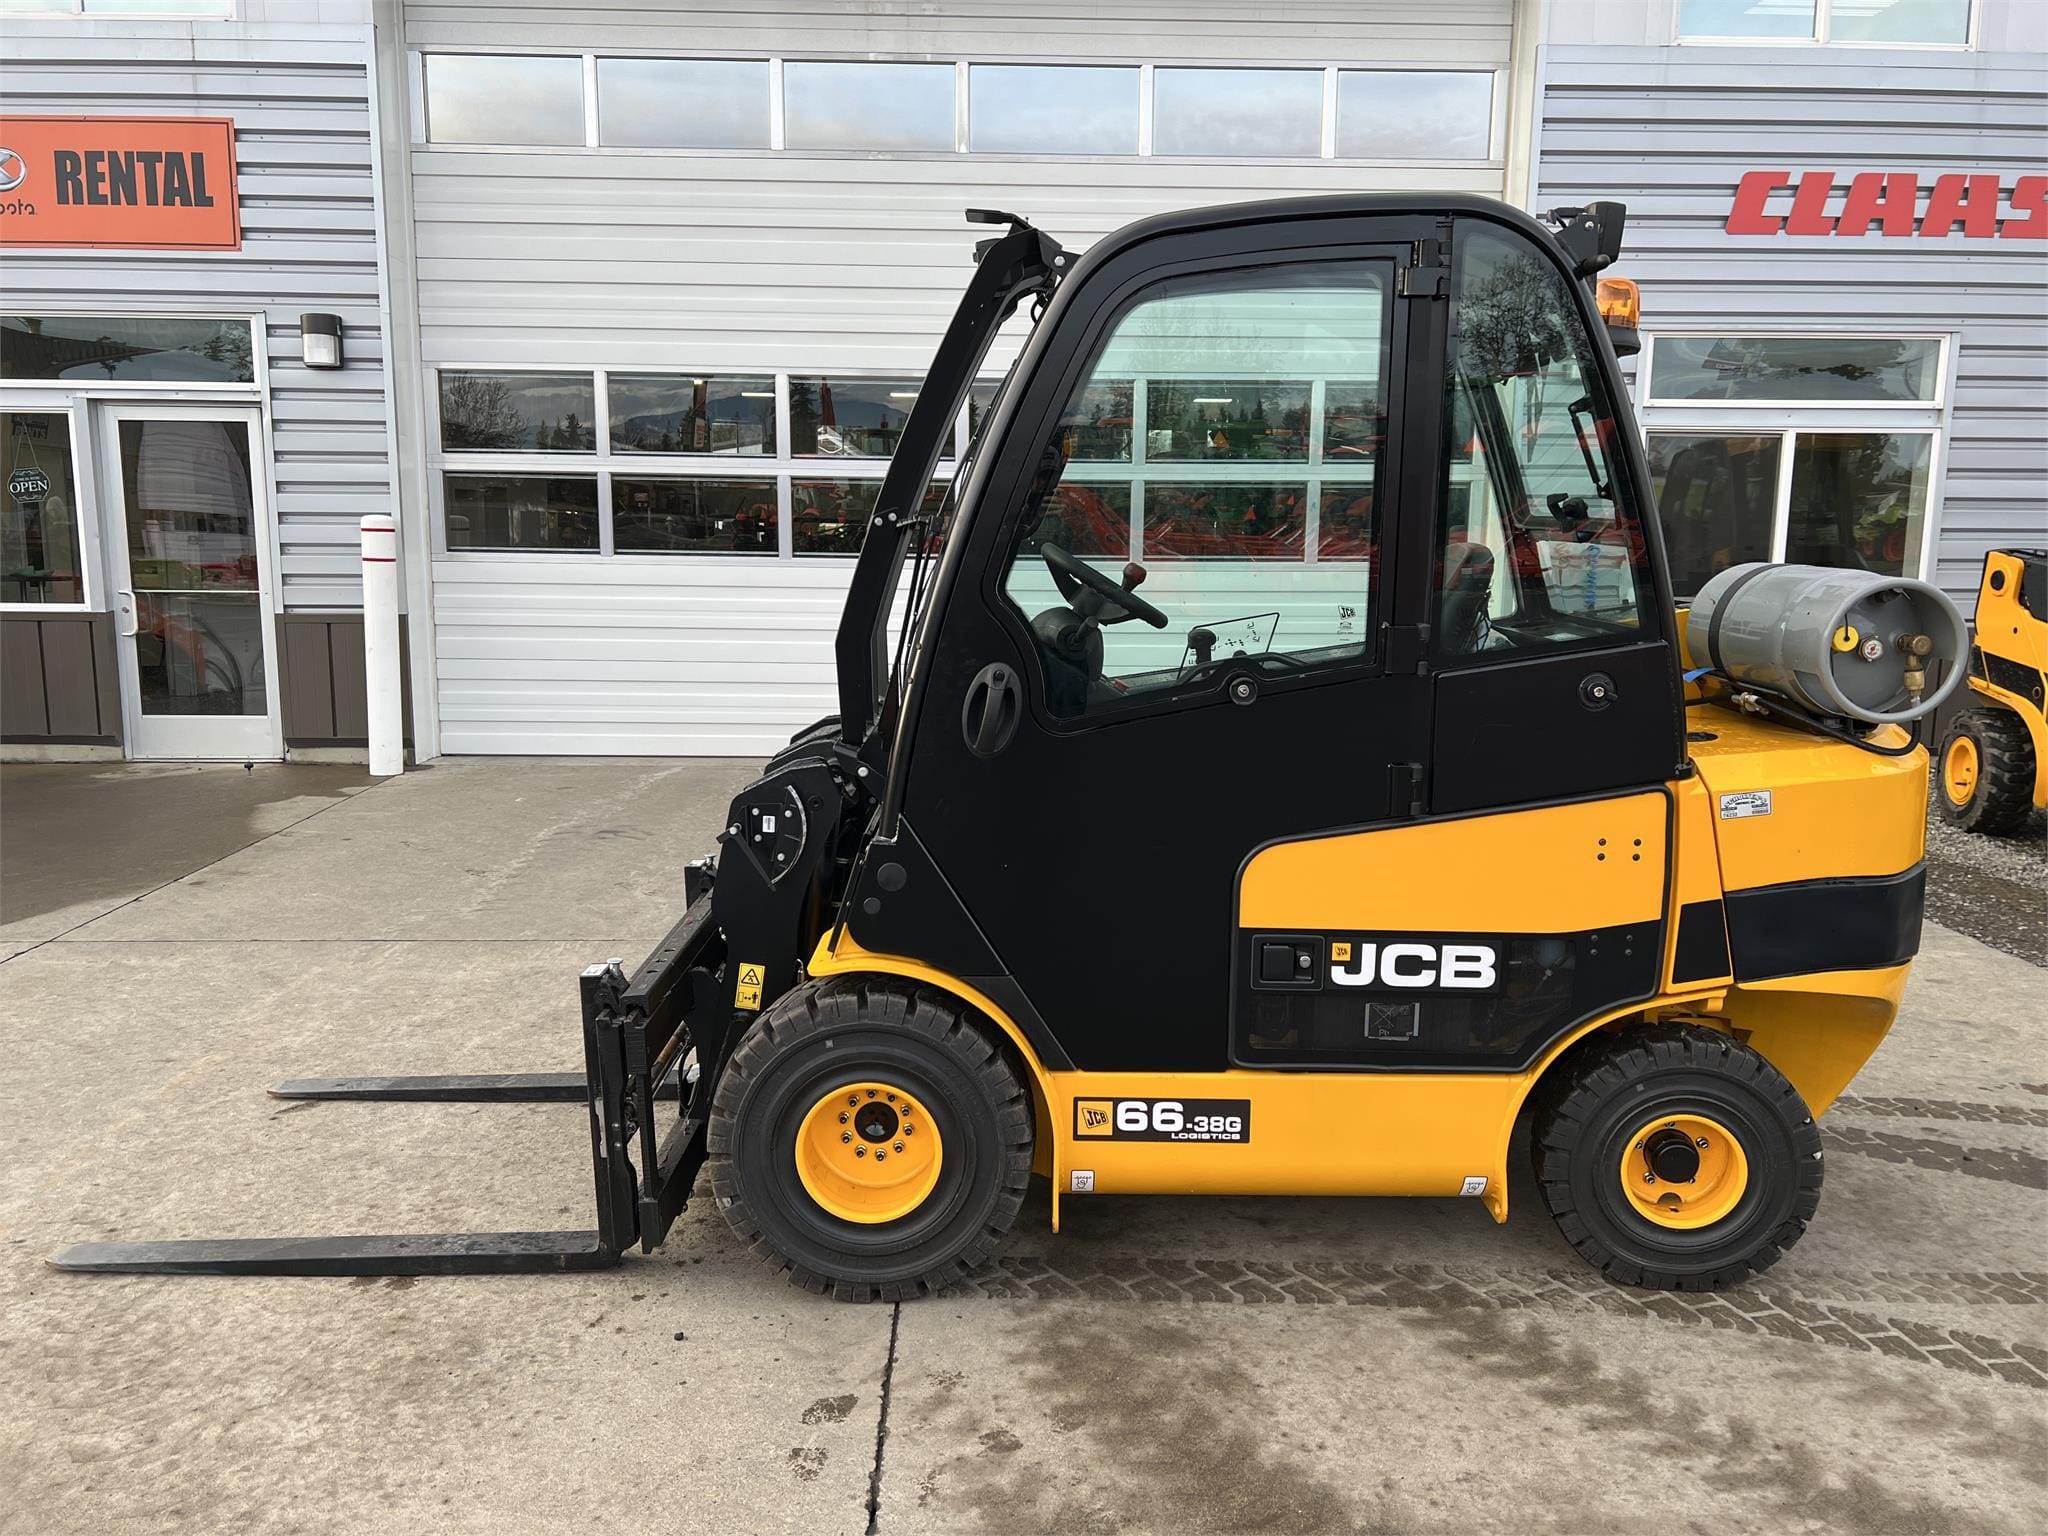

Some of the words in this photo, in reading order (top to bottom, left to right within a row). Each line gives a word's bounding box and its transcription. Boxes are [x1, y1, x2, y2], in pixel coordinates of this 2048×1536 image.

[54, 149, 214, 208] RENTAL
[9, 480, 48, 494] OPEN
[1330, 943, 1497, 988] JCB
[1086, 1110, 1107, 1126] JCB
